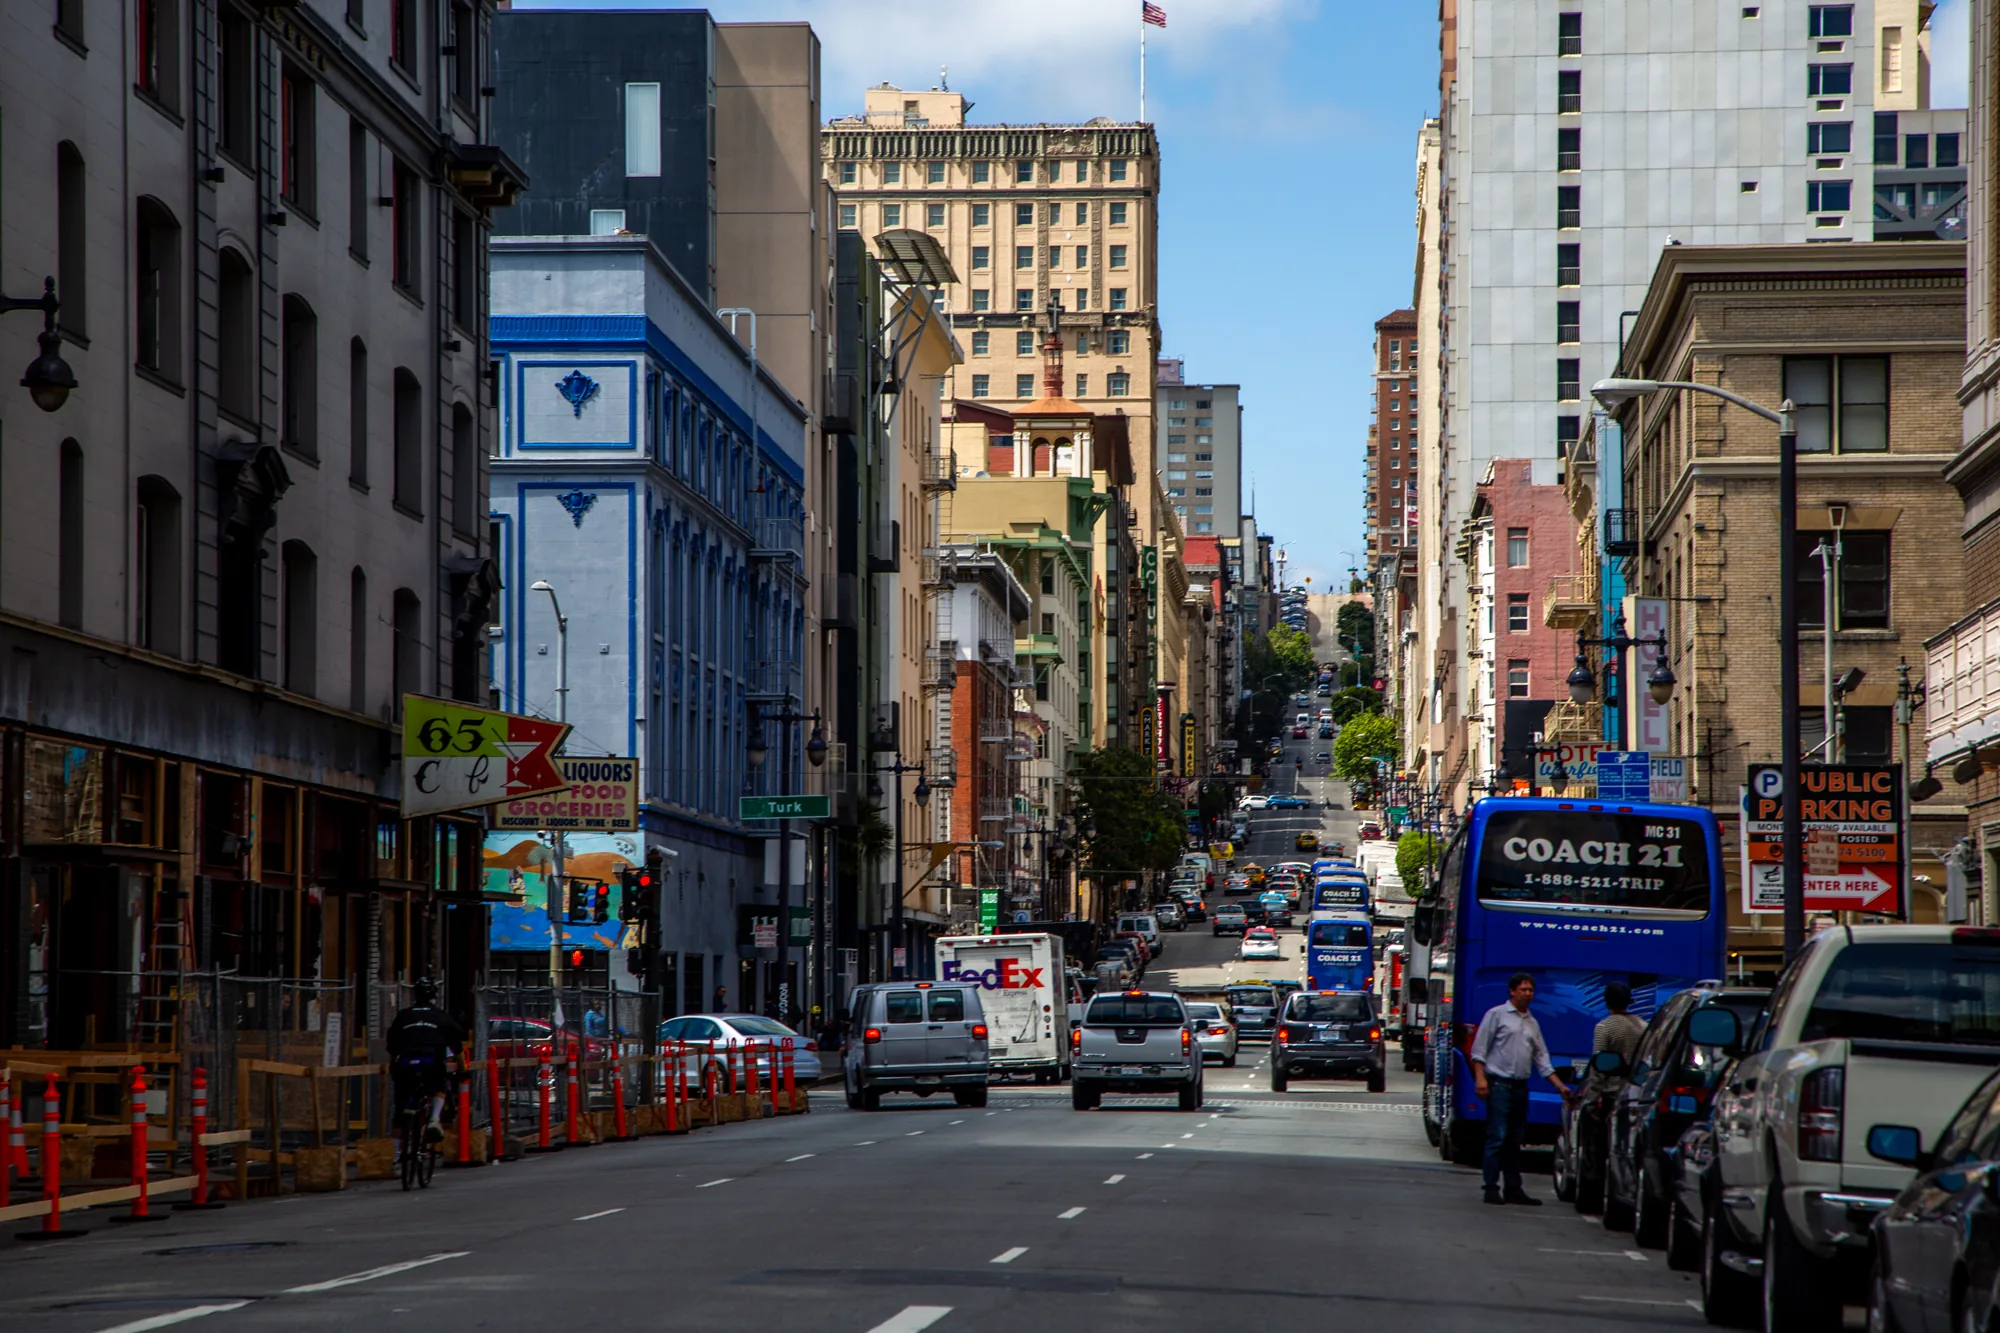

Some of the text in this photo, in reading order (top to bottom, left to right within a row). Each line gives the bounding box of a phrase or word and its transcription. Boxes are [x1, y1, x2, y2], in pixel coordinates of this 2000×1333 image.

[416, 715, 486, 753] 65
[1539, 746, 1612, 763] HOTE
[563, 762, 632, 783] LIQUORS
[571, 785, 627, 800] FOOD
[508, 801, 626, 818] GROCERIES
[768, 801, 802, 813] Turk
[501, 817, 631, 828] DISCOUNT LIQUORS WINE BEER
[1842, 824, 1887, 832] AVAILABLE
[1645, 825, 1681, 839] MC 31
[1840, 835, 1879, 843] POSTED
[1503, 837, 1685, 868] COACH 21
[1856, 847, 1886, 857] 5100
[1524, 873, 1665, 891] 1-888-521-TRIP
[1845, 881, 1879, 891] HERE
[1322, 890, 1361, 898] COACH 21
[1519, 921, 1665, 936] www.coach21.com
[1317, 954, 1362, 962] COACH 21
[942, 958, 1045, 991] FedEx
